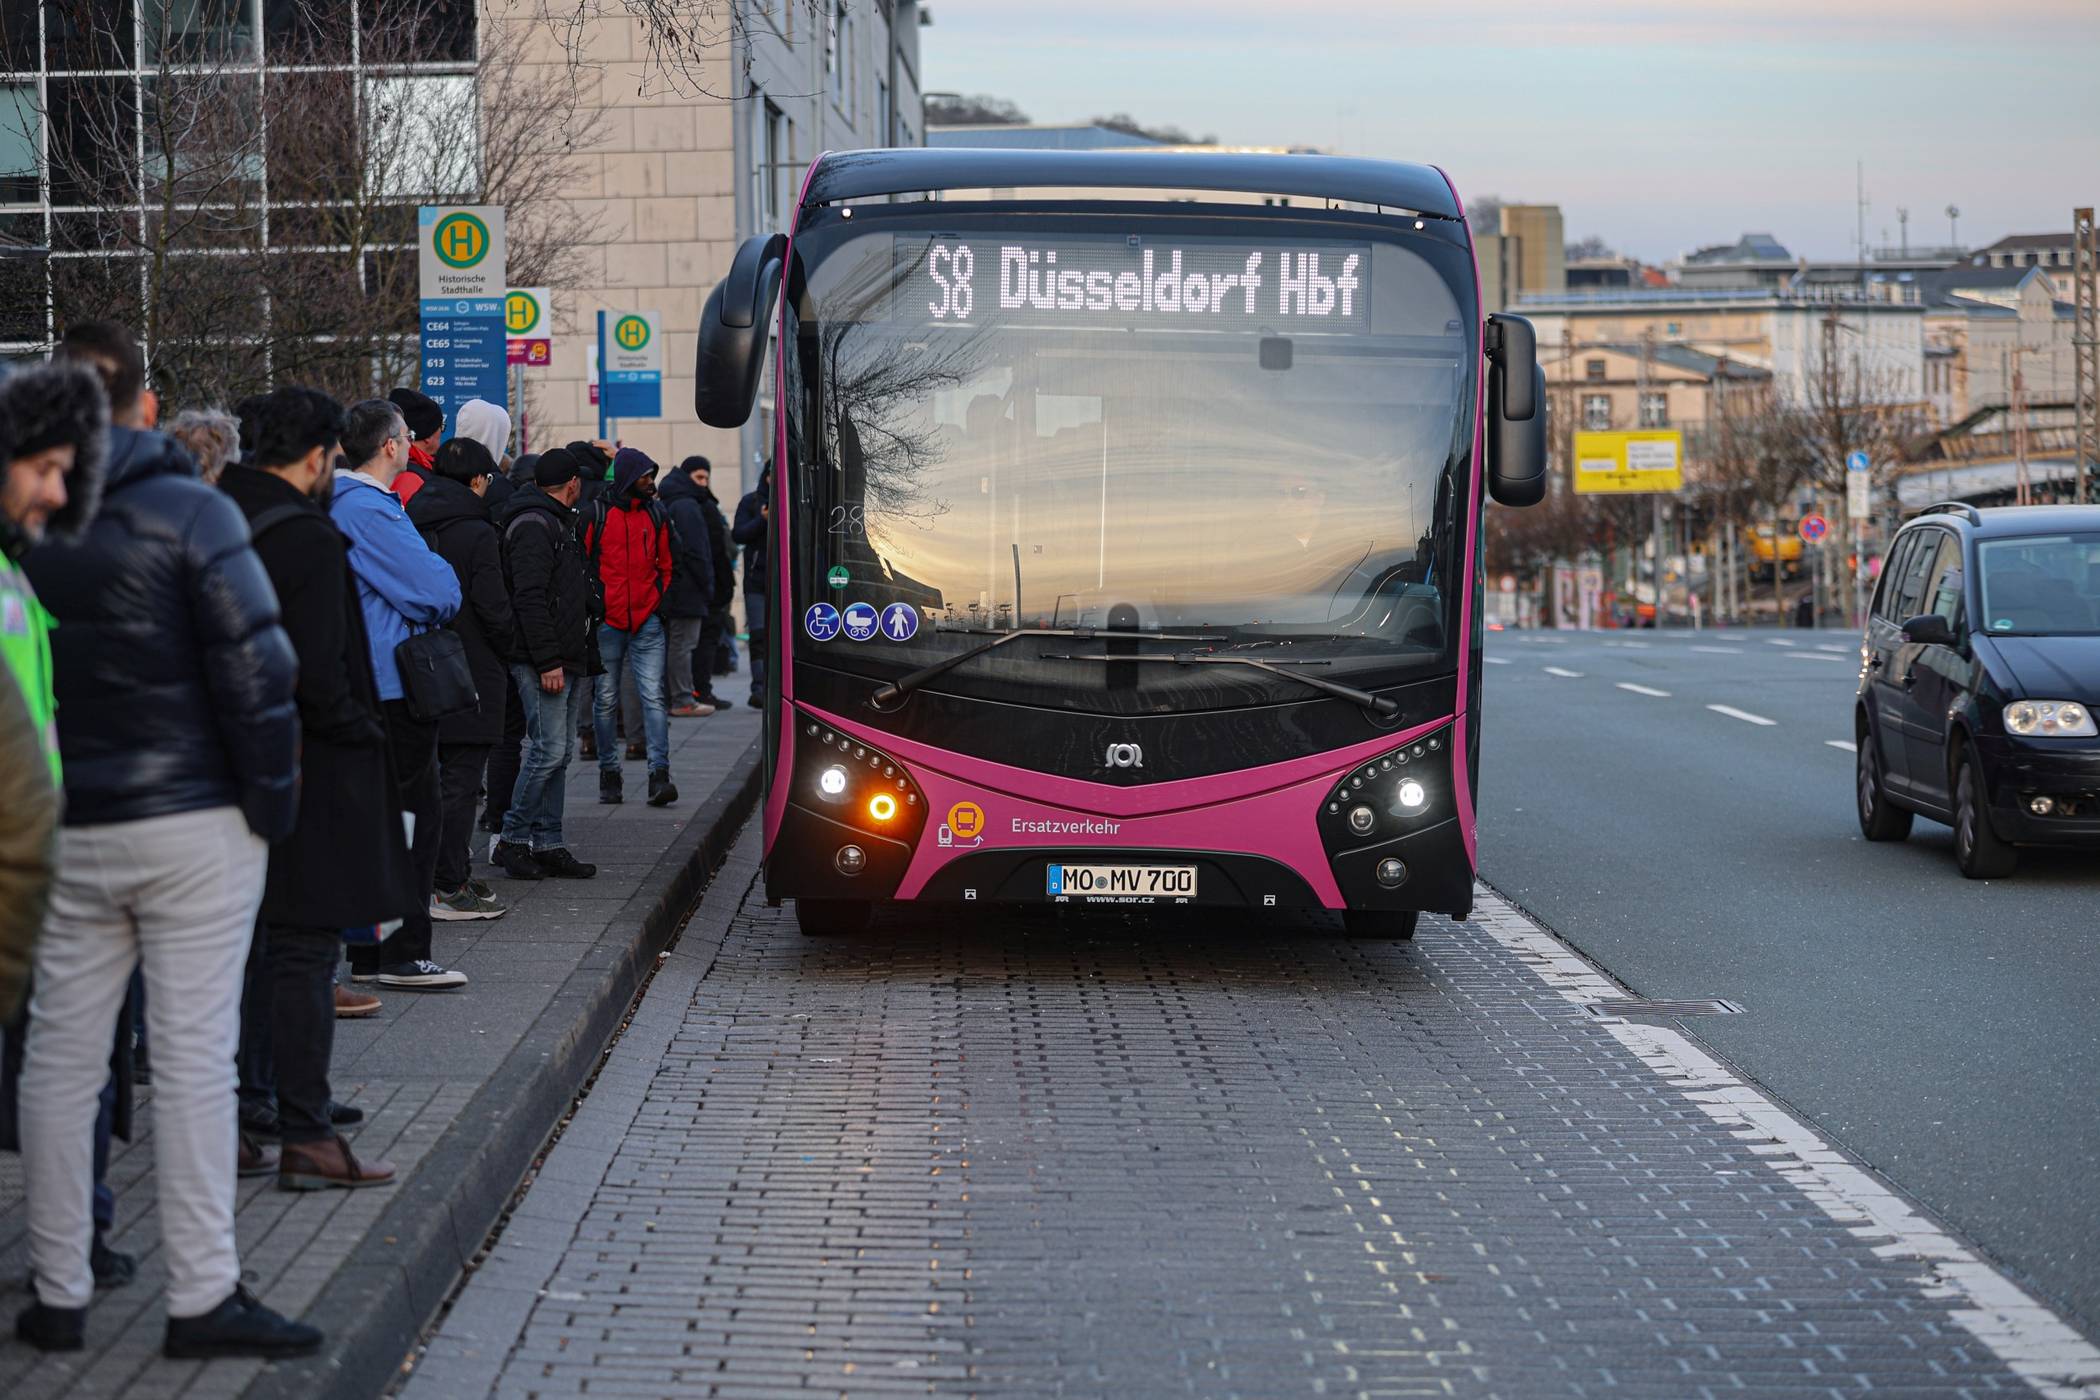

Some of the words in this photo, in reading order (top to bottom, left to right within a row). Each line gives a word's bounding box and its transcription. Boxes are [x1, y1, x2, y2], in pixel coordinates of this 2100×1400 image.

[450, 225, 473, 256] H
[438, 274, 486, 283] Historische
[929, 245, 974, 318] S8
[1000, 246, 1262, 313] Düsseldorf
[1279, 252, 1359, 316] Hbf
[441, 285, 484, 294] Stadthalle
[426, 322, 449, 331] CE64
[426, 339, 450, 348] CE65
[427, 358, 445, 368] 613
[427, 376, 445, 386] 623
[1012, 817, 1121, 835] Ersatzverkehr
[1063, 869, 1094, 890] MO
[1110, 869, 1141, 891] MV
[1147, 870, 1192, 892] 700
[1086, 896, 1155, 904] www.sor.cz
